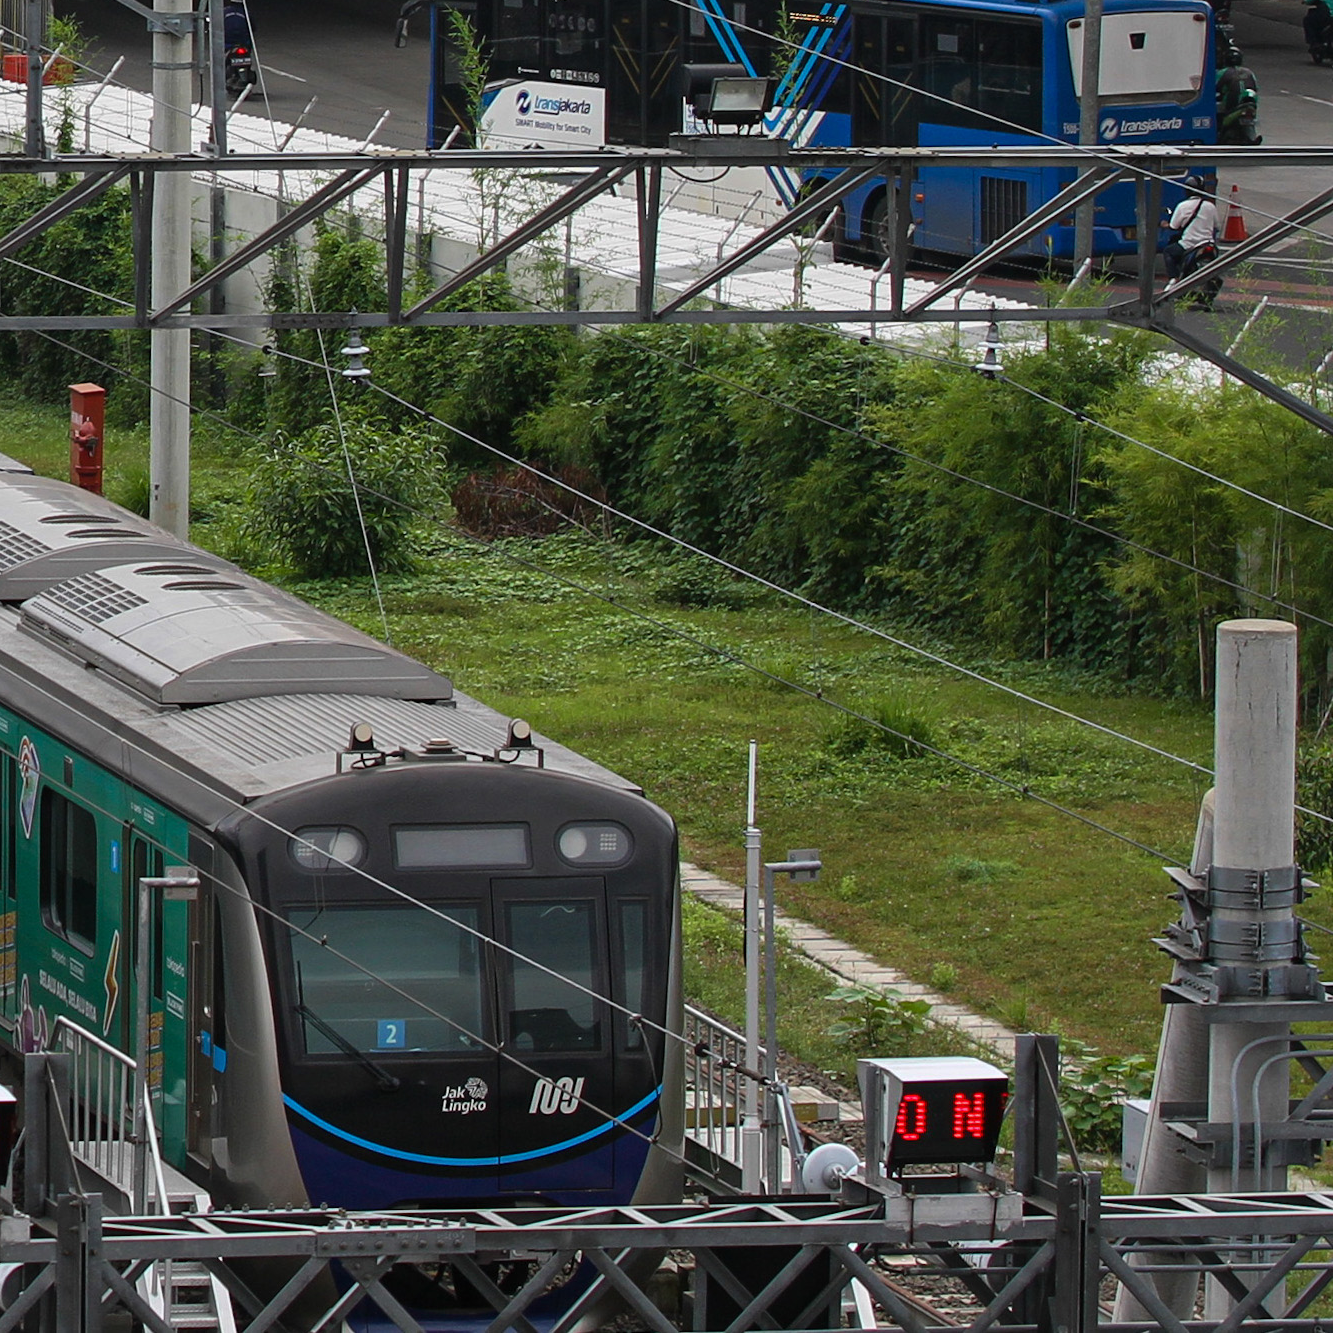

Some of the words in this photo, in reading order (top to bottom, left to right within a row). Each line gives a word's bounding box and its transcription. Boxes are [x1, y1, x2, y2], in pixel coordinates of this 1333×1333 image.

[534, 94, 592, 115] transjakarta
[515, 118, 534, 127] SMART
[535, 120, 555, 132] Mobility
[564, 123, 579, 133] Smart
[580, 124, 592, 136] City
[1121, 116, 1183, 136] transjakarta
[386, 1024, 397, 1044] 2
[442, 1086, 466, 1099] Jak
[442, 1099, 487, 1115] Lingko
